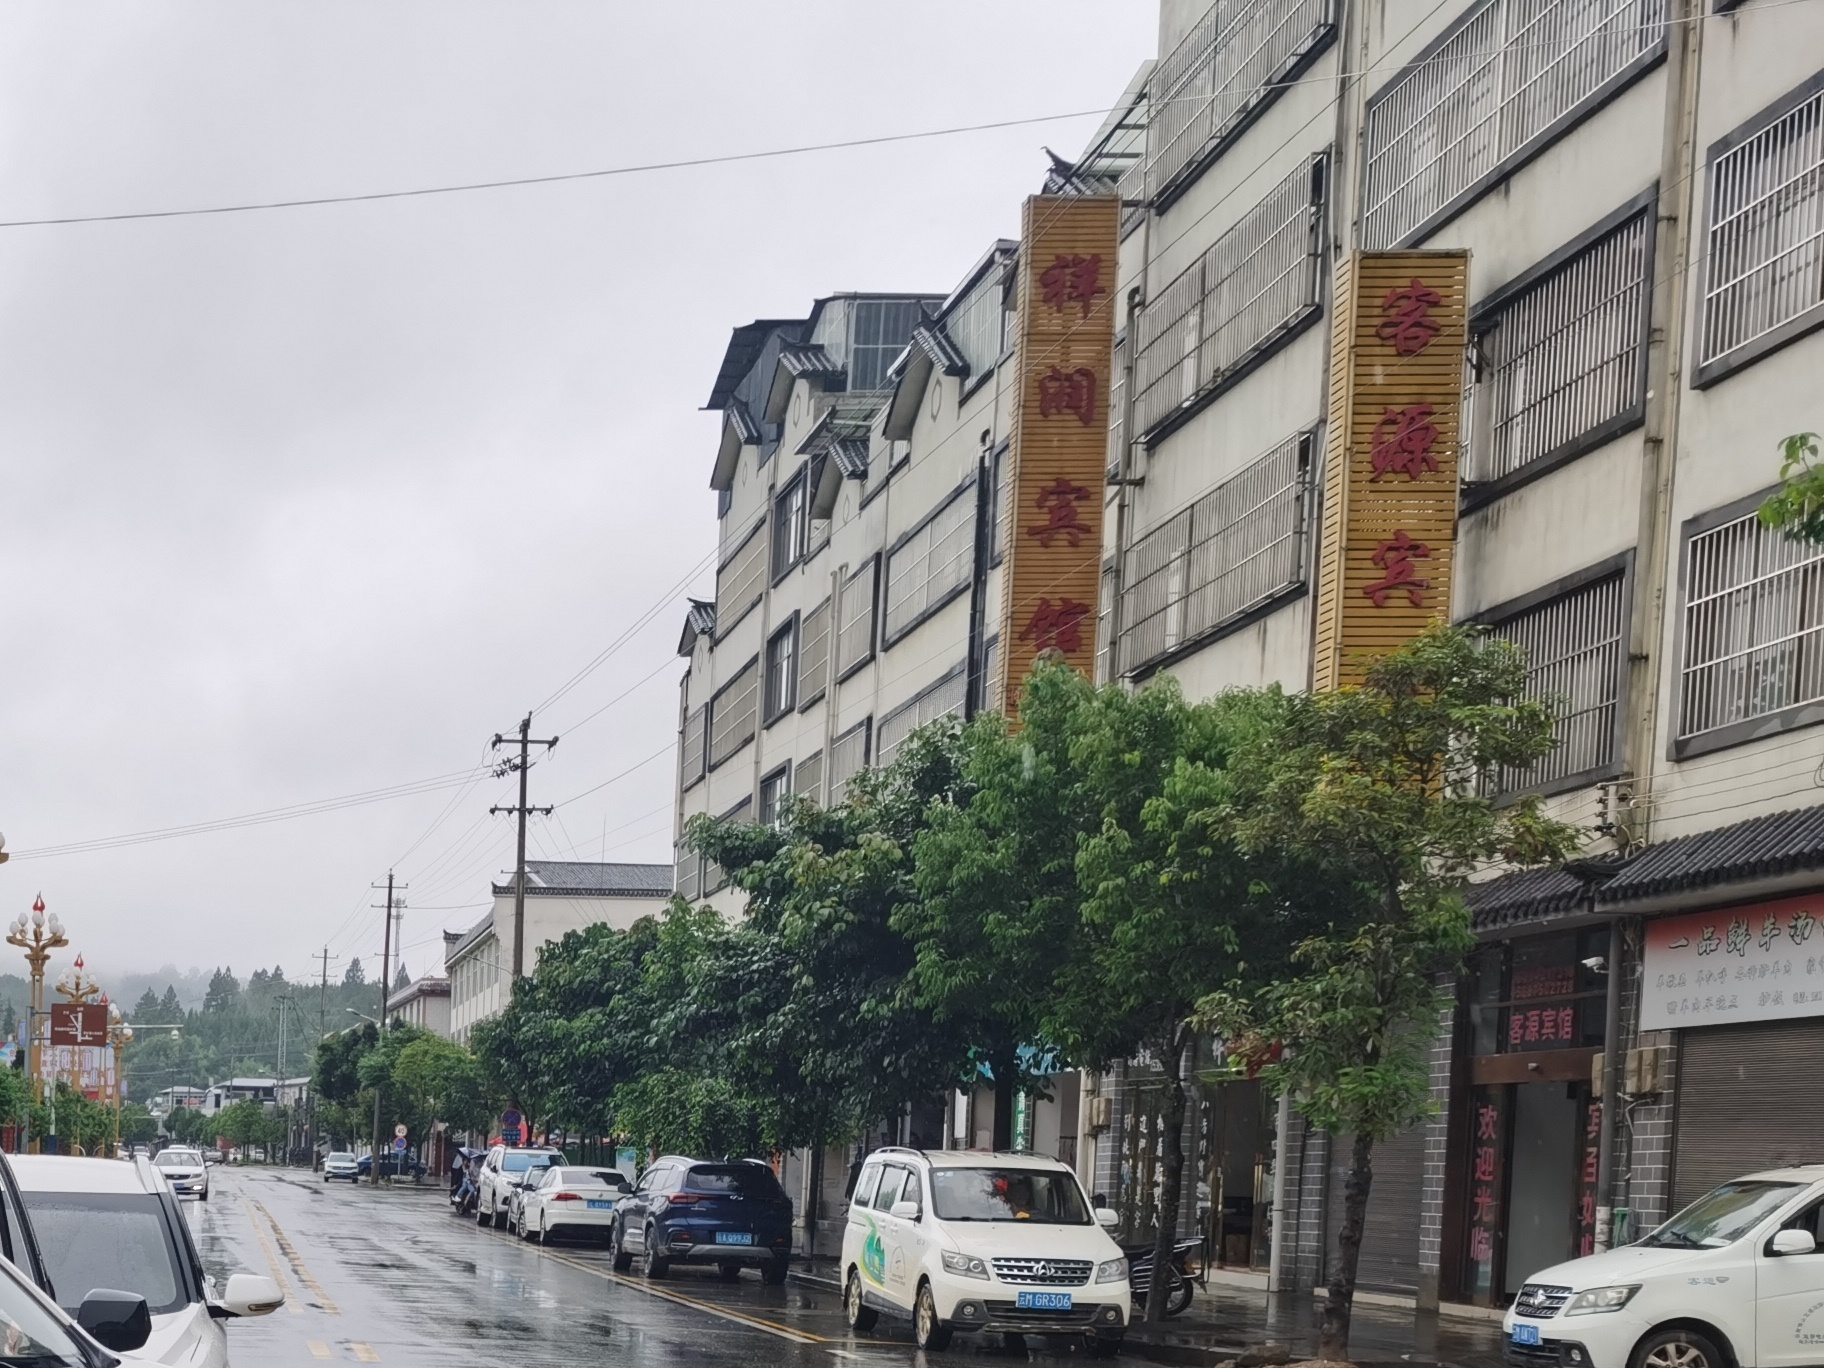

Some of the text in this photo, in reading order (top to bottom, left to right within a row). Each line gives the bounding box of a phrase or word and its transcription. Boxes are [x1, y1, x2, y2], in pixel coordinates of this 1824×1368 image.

[1509, 1006, 1574, 1044] 客源宾馆
[1470, 1104, 1498, 1262] 欢迎光临
